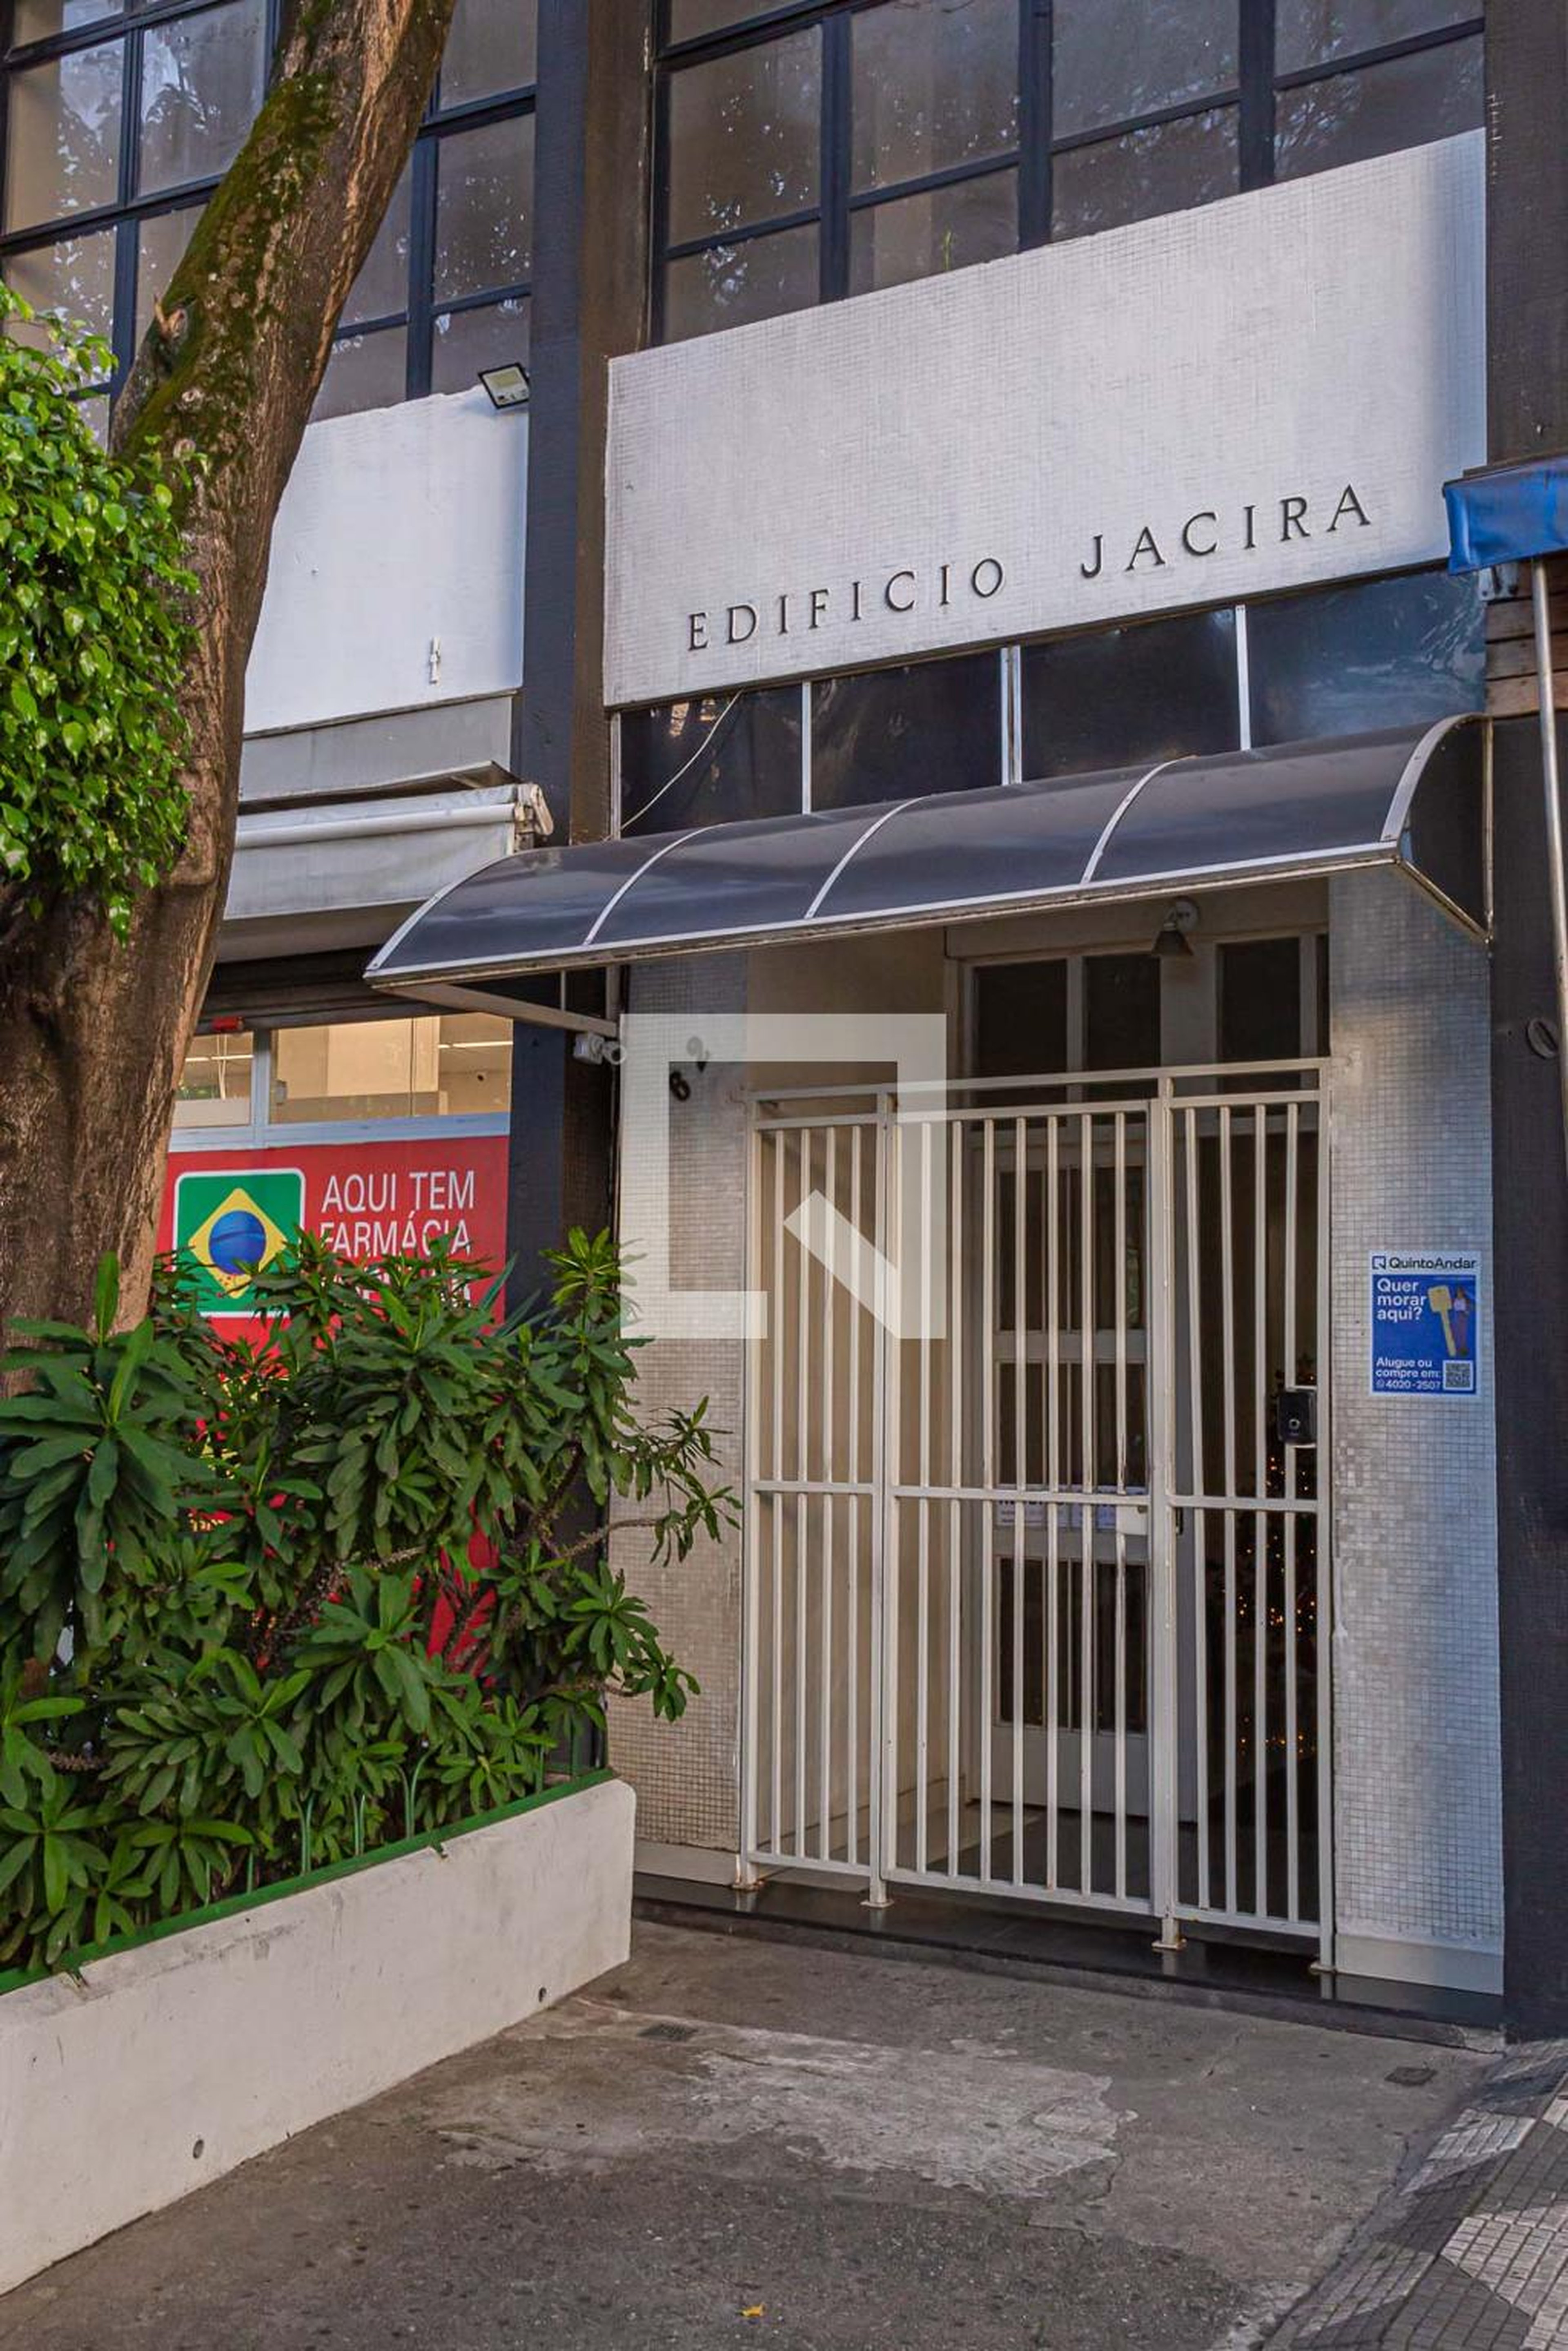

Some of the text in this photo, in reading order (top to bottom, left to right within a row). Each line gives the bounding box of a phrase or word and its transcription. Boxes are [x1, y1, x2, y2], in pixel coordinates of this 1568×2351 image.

[688, 484, 1371, 652] EDIFICIO JACIRA
[322, 1170, 475, 1213] AQUI TEM
[1389, 1257, 1477, 1269] QuintoAndar
[1377, 1278, 1419, 1292] Quer
[1377, 1295, 1426, 1306] morar
[1377, 1307, 1422, 1322] aqui?
[1376, 1358, 1415, 1368] Alugue
[1376, 1370, 1419, 1378] compre
